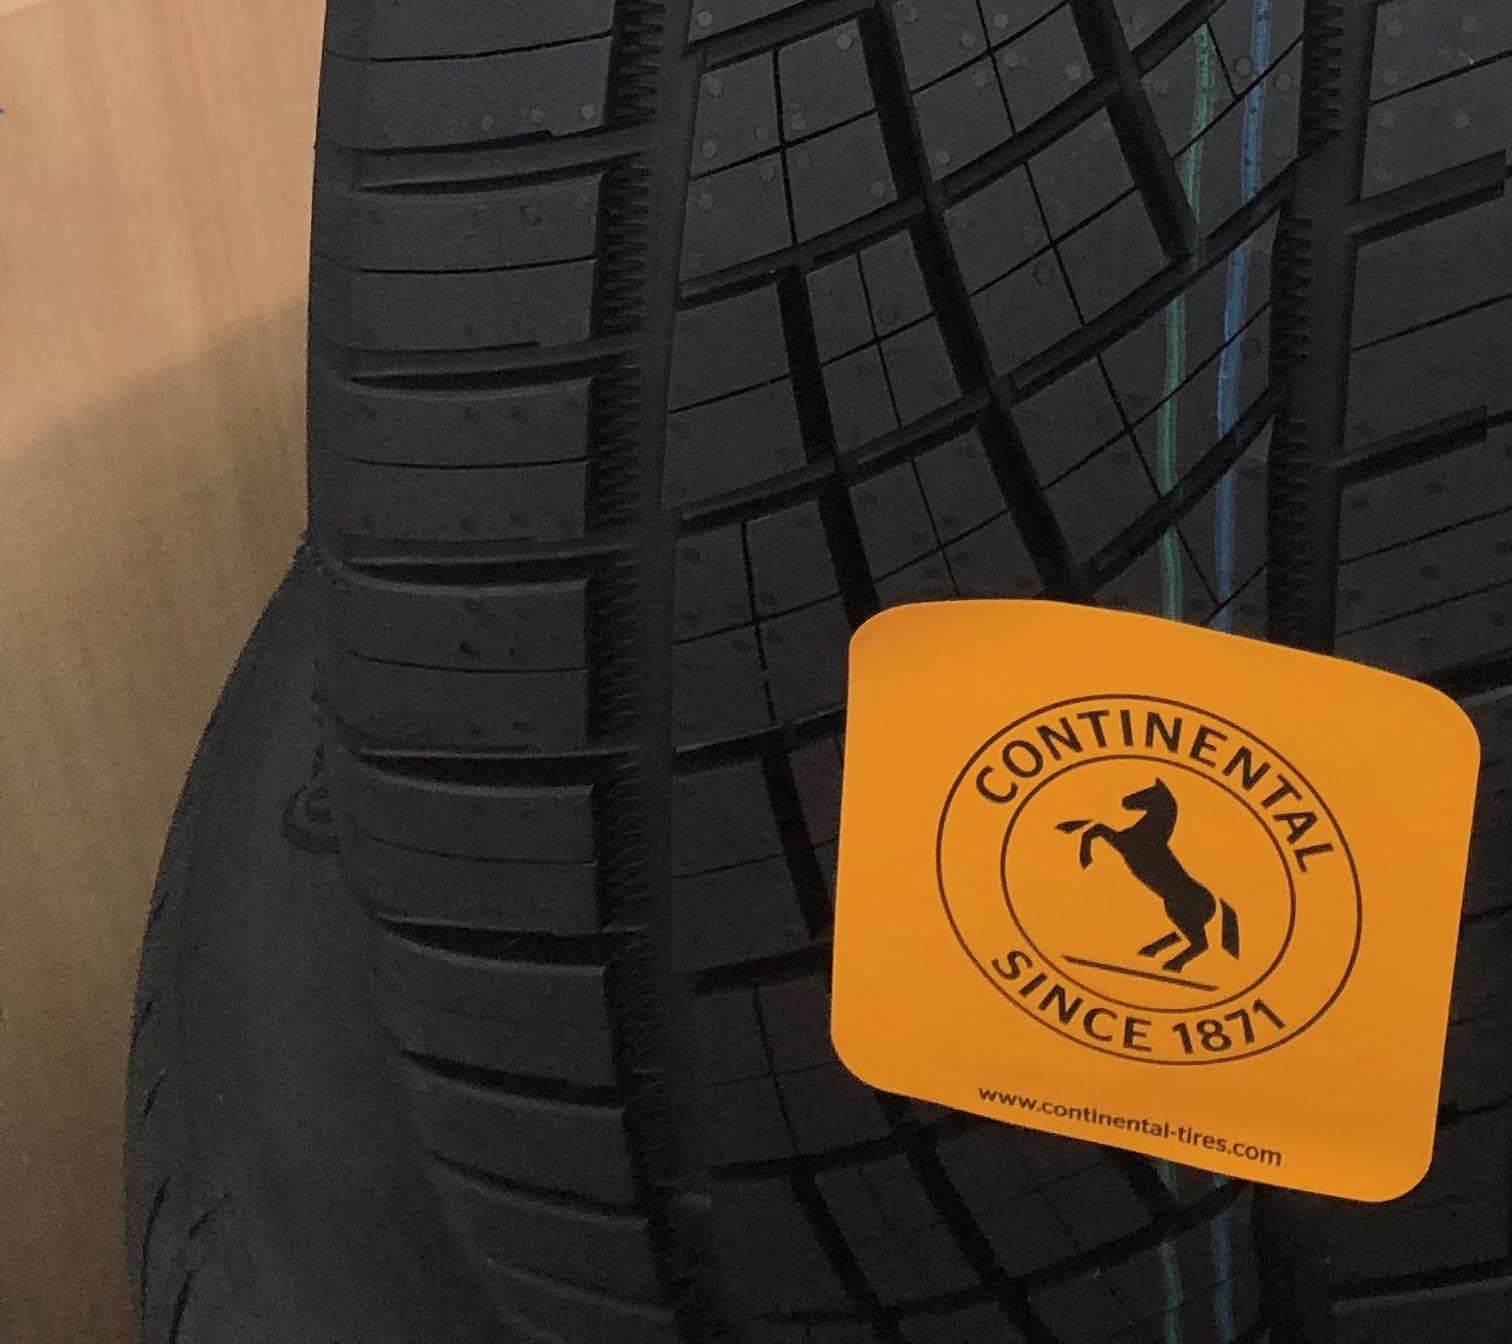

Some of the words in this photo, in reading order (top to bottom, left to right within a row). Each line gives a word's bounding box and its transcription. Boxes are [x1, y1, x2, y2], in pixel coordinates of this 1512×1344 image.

[974, 708, 1334, 873] CONTINENTAL
[990, 949, 1153, 1052] SINCE
[1172, 998, 1286, 1055] 1871
[977, 1083, 1283, 1167] www.continental-tires.com
